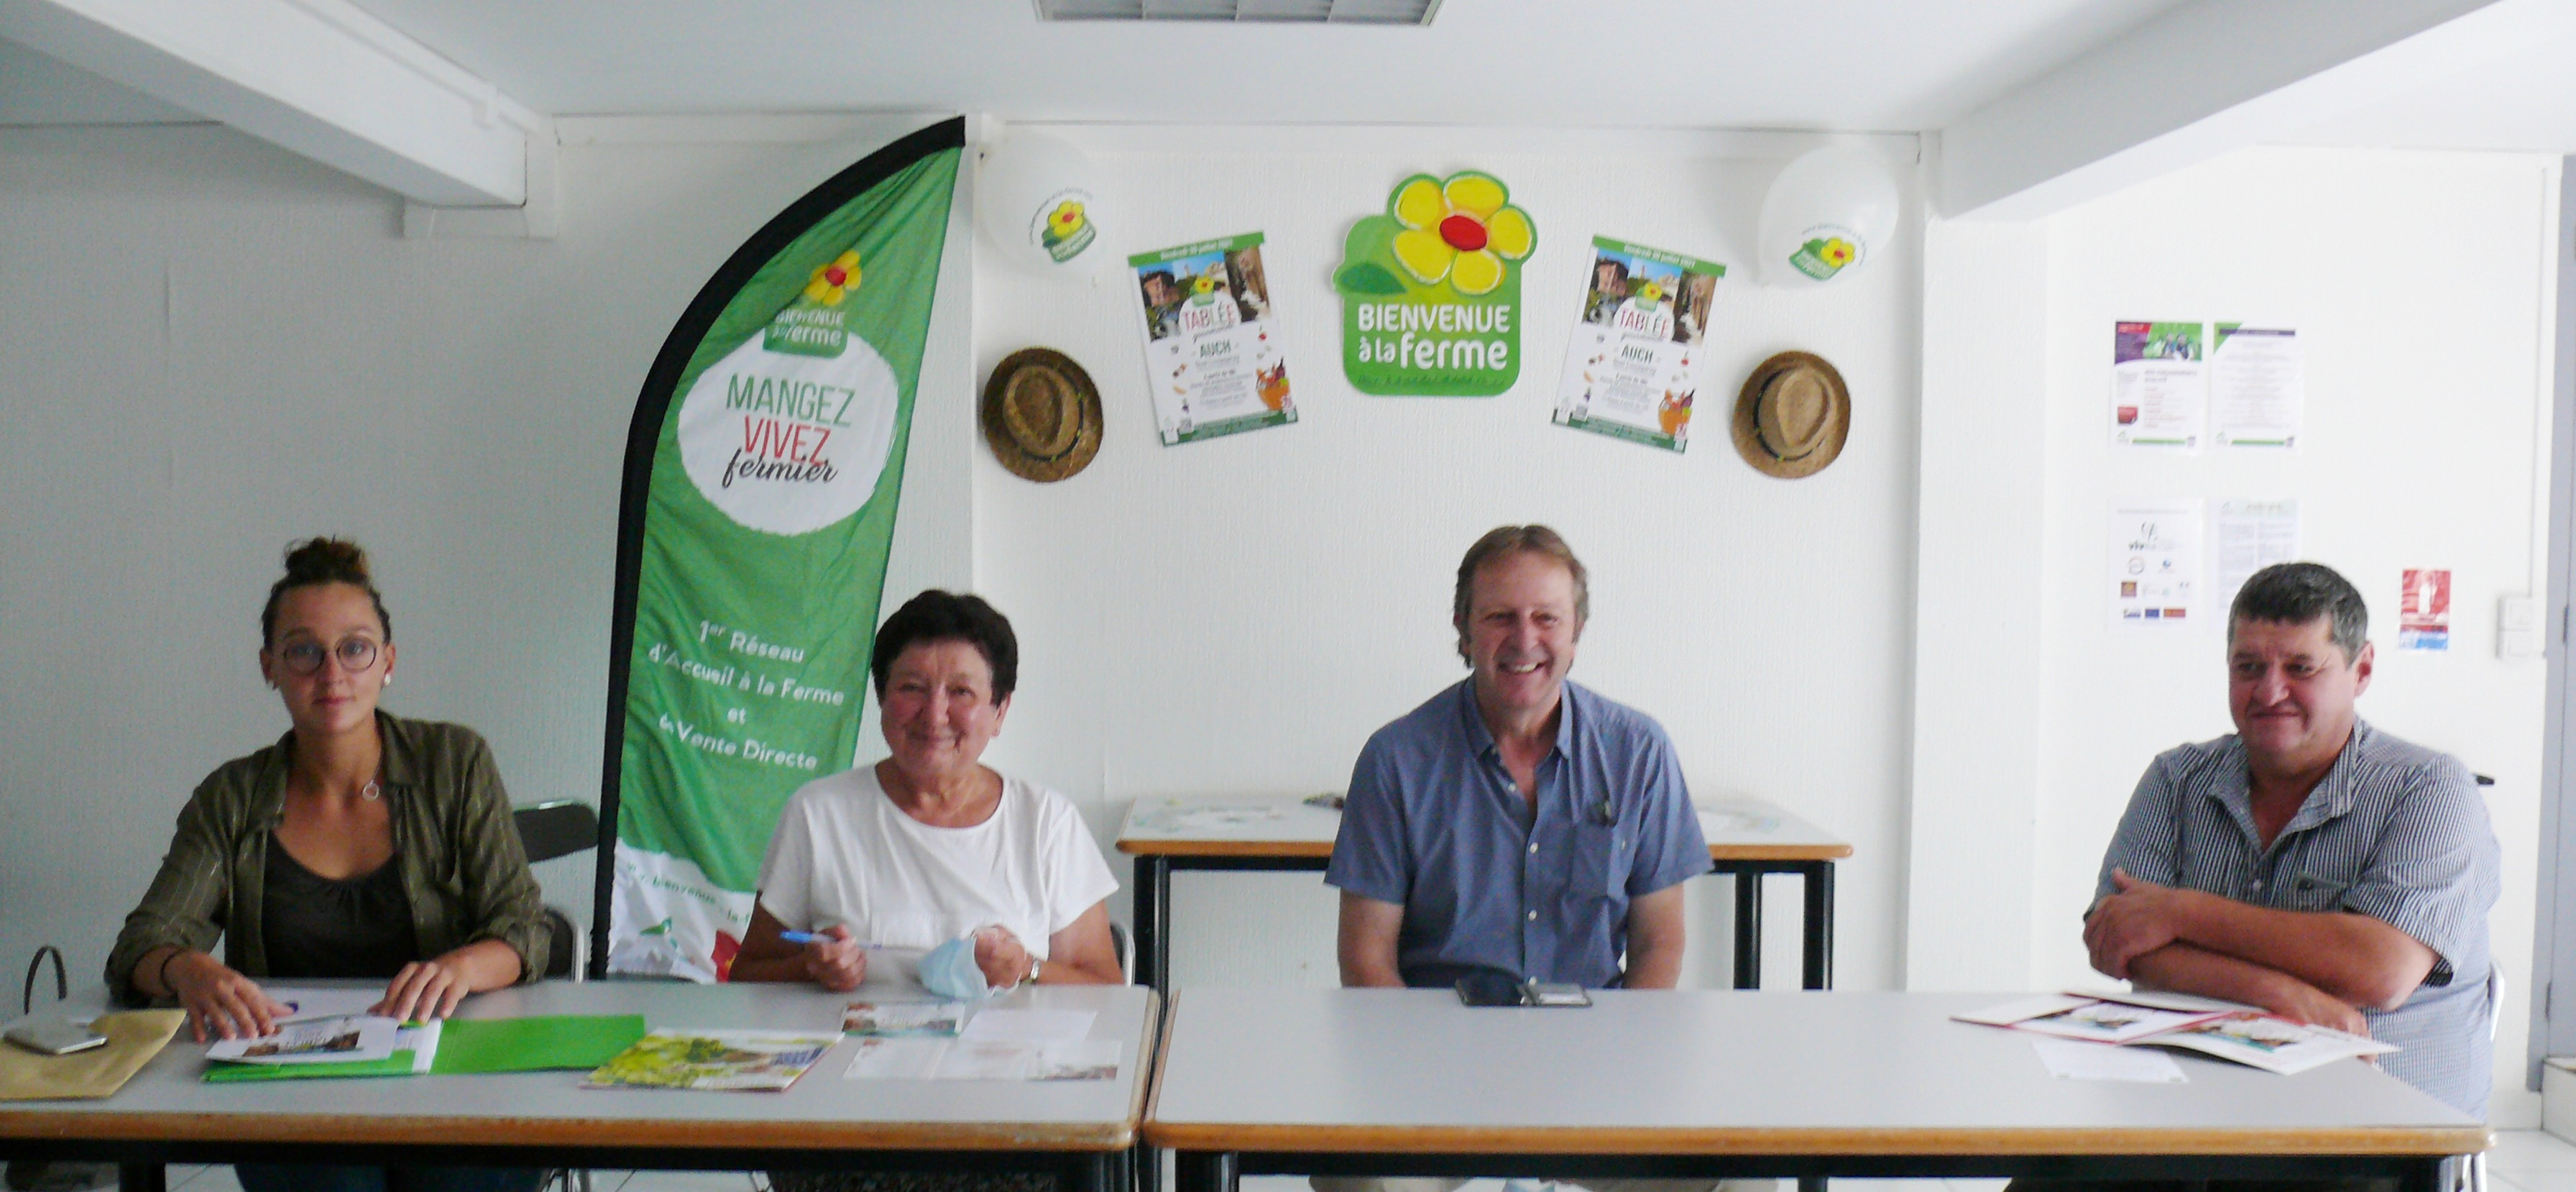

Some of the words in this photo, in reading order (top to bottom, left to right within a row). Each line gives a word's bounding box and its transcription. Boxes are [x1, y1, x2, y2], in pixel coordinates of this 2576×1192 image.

[1184, 301, 1236, 331] TABLÉE
[1358, 303, 1511, 334] BIENVENUE
[1620, 308, 1671, 339] TABLÉE
[1200, 339, 1231, 359] AUCH
[1358, 335, 1372, 363] à
[1375, 336, 1397, 364] la
[1400, 331, 1508, 370] ferme
[1621, 344, 1654, 364] AUCH
[726, 372, 855, 428] MANGEZ
[745, 413, 831, 467] VIVEZ
[722, 447, 838, 490] fermier
[700, 620, 727, 643] 1er
[730, 630, 805, 664] Réseau
[648, 642, 735, 686] d'Accueil
[757, 674, 775, 696] la
[781, 678, 845, 707] Ferme
[727, 707, 747, 725] et
[676, 720, 737, 756] Vente
[742, 738, 818, 771] Directe
